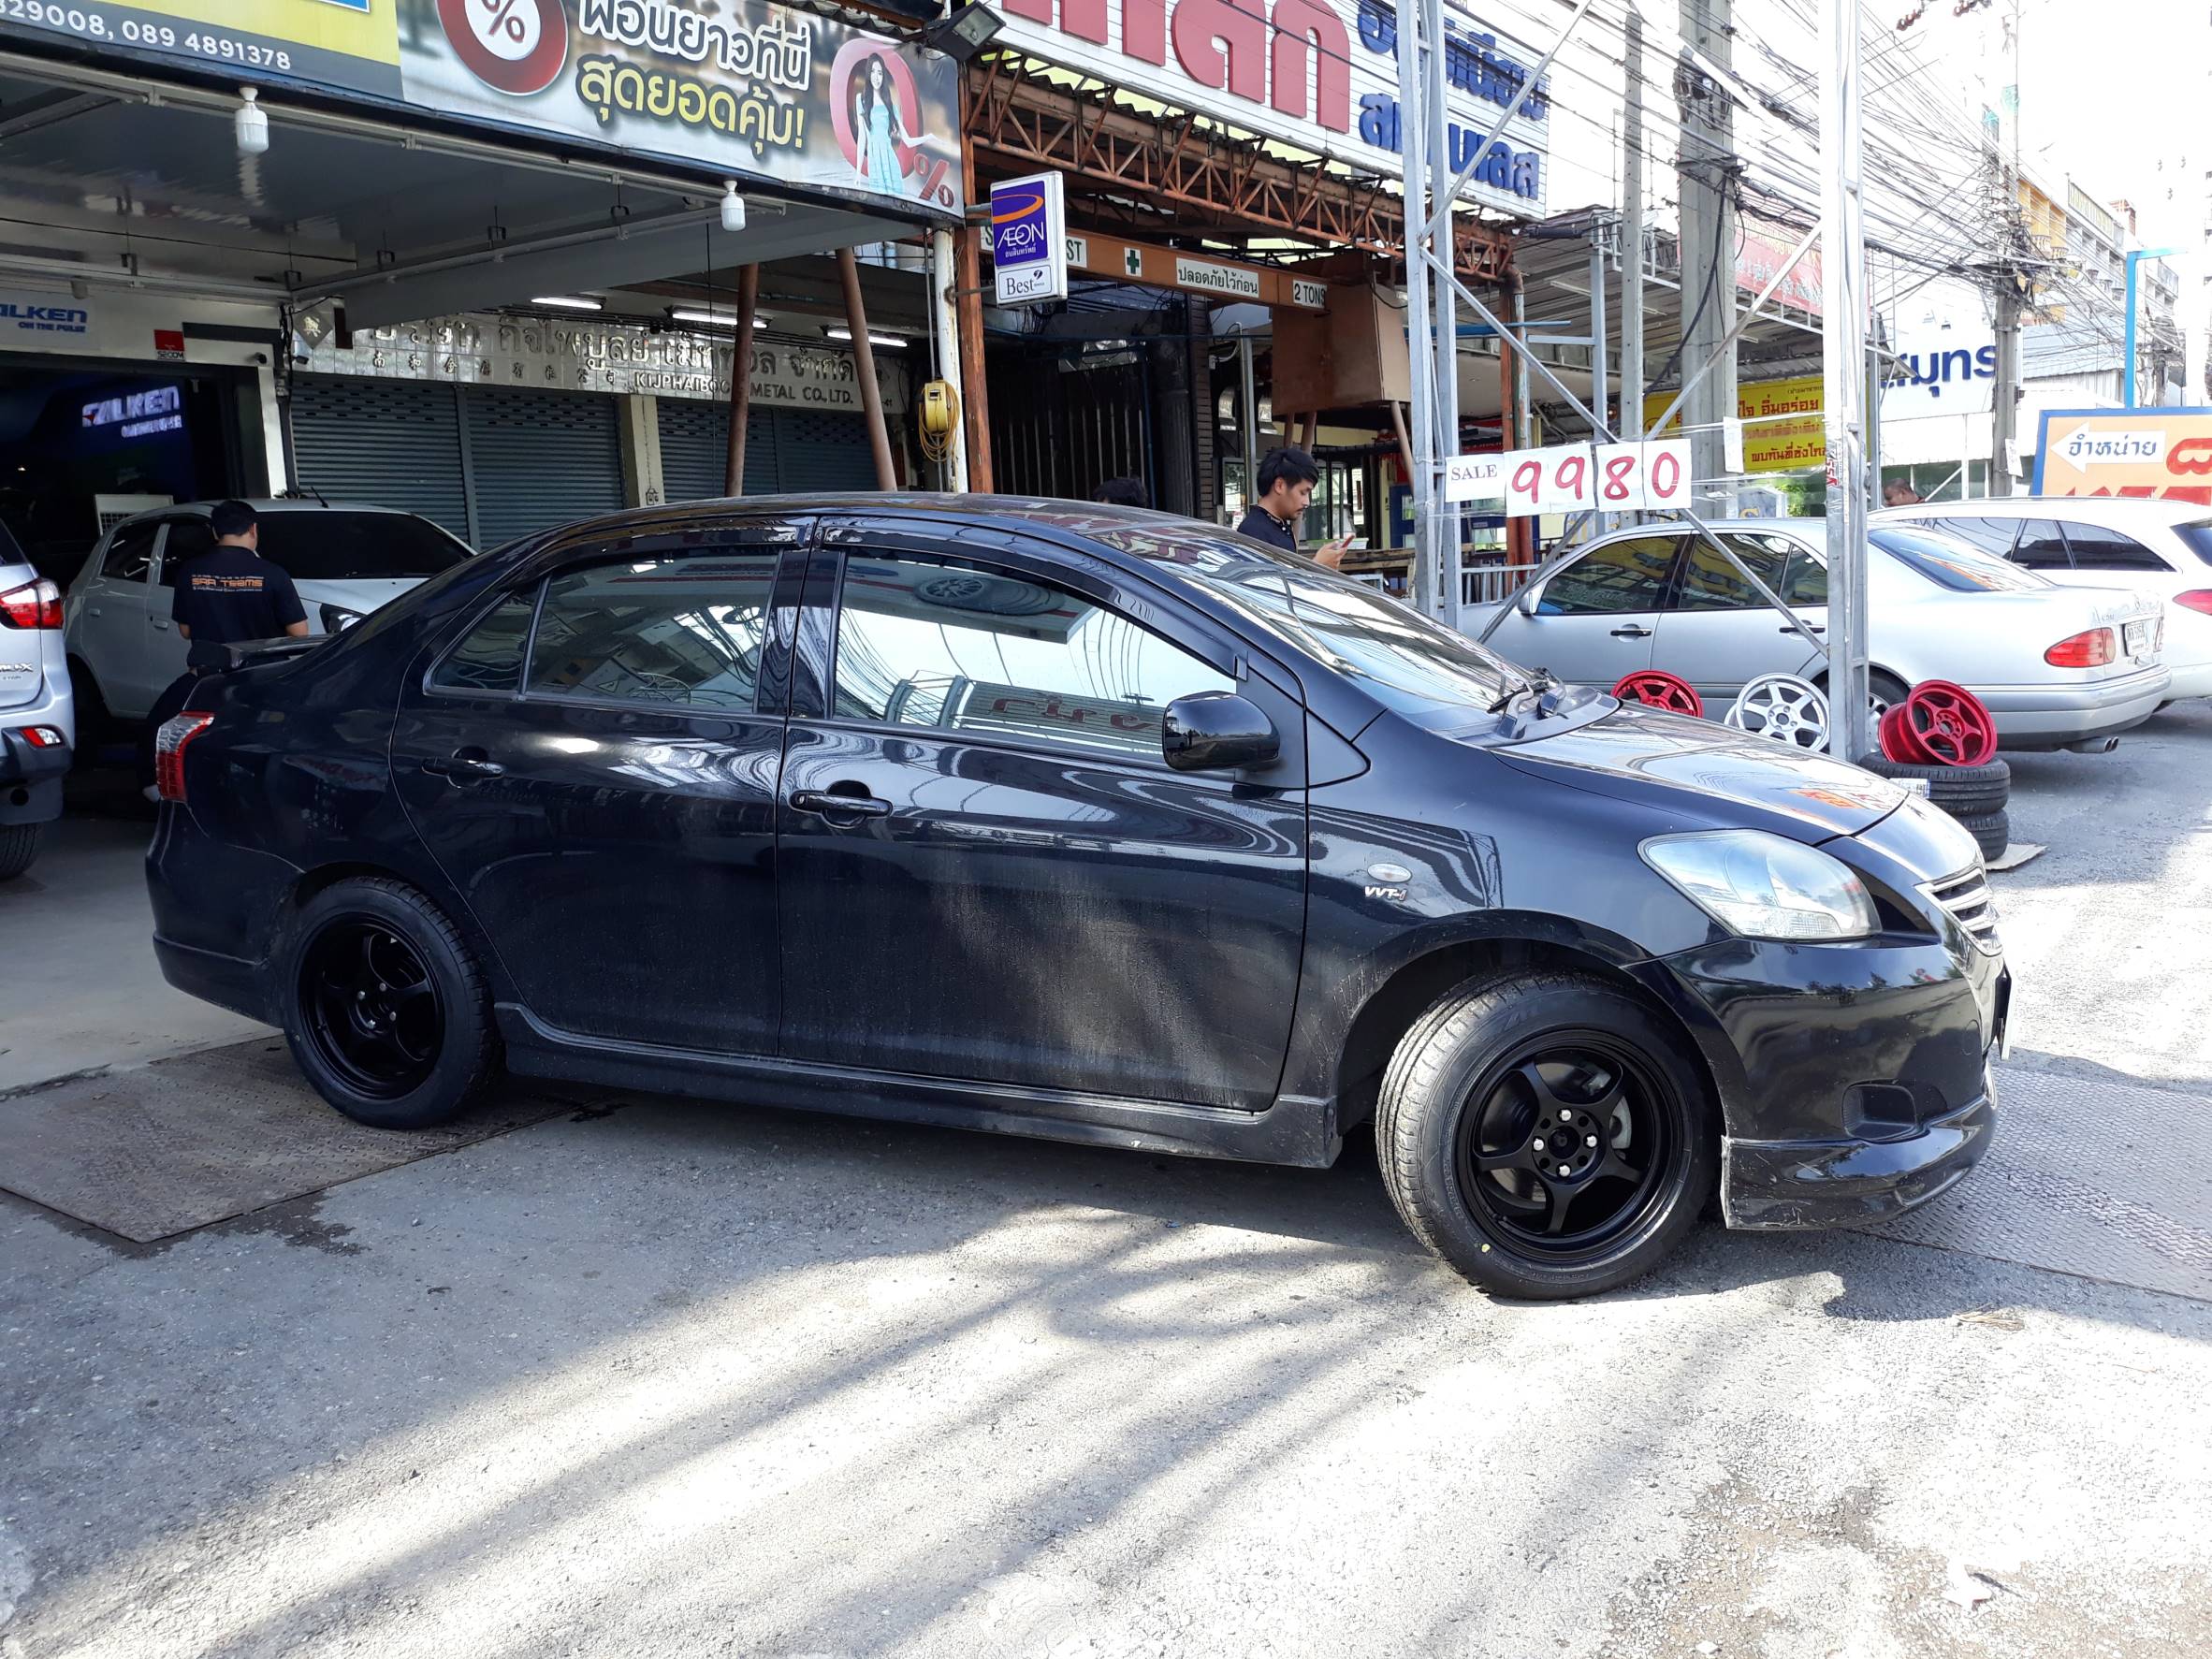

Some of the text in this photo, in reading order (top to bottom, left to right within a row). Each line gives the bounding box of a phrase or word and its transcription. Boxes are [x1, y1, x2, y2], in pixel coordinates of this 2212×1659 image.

[122, 20, 175, 47] 089
[184, 33, 291, 70] 4891378
[581, 0, 809, 88] ผอนยาวที่นี่
[578, 58, 806, 157] สุดยอดคุ้ม!
[1359, 93, 1540, 200] สนเลส
[1067, 239, 1082, 263] ST
[1006, 276, 1034, 296] Best
[1178, 269, 1259, 295] ปลอดภัยไว้ก่อน
[1294, 283, 1326, 304] 2 TONS
[634, 371, 735, 394] KIJPHAIBOO
[749, 381, 796, 400] METAL
[82, 386, 180, 427] FALKEN
[2068, 433, 2157, 457] จำหน่าย
[1451, 464, 1497, 481] SALE
